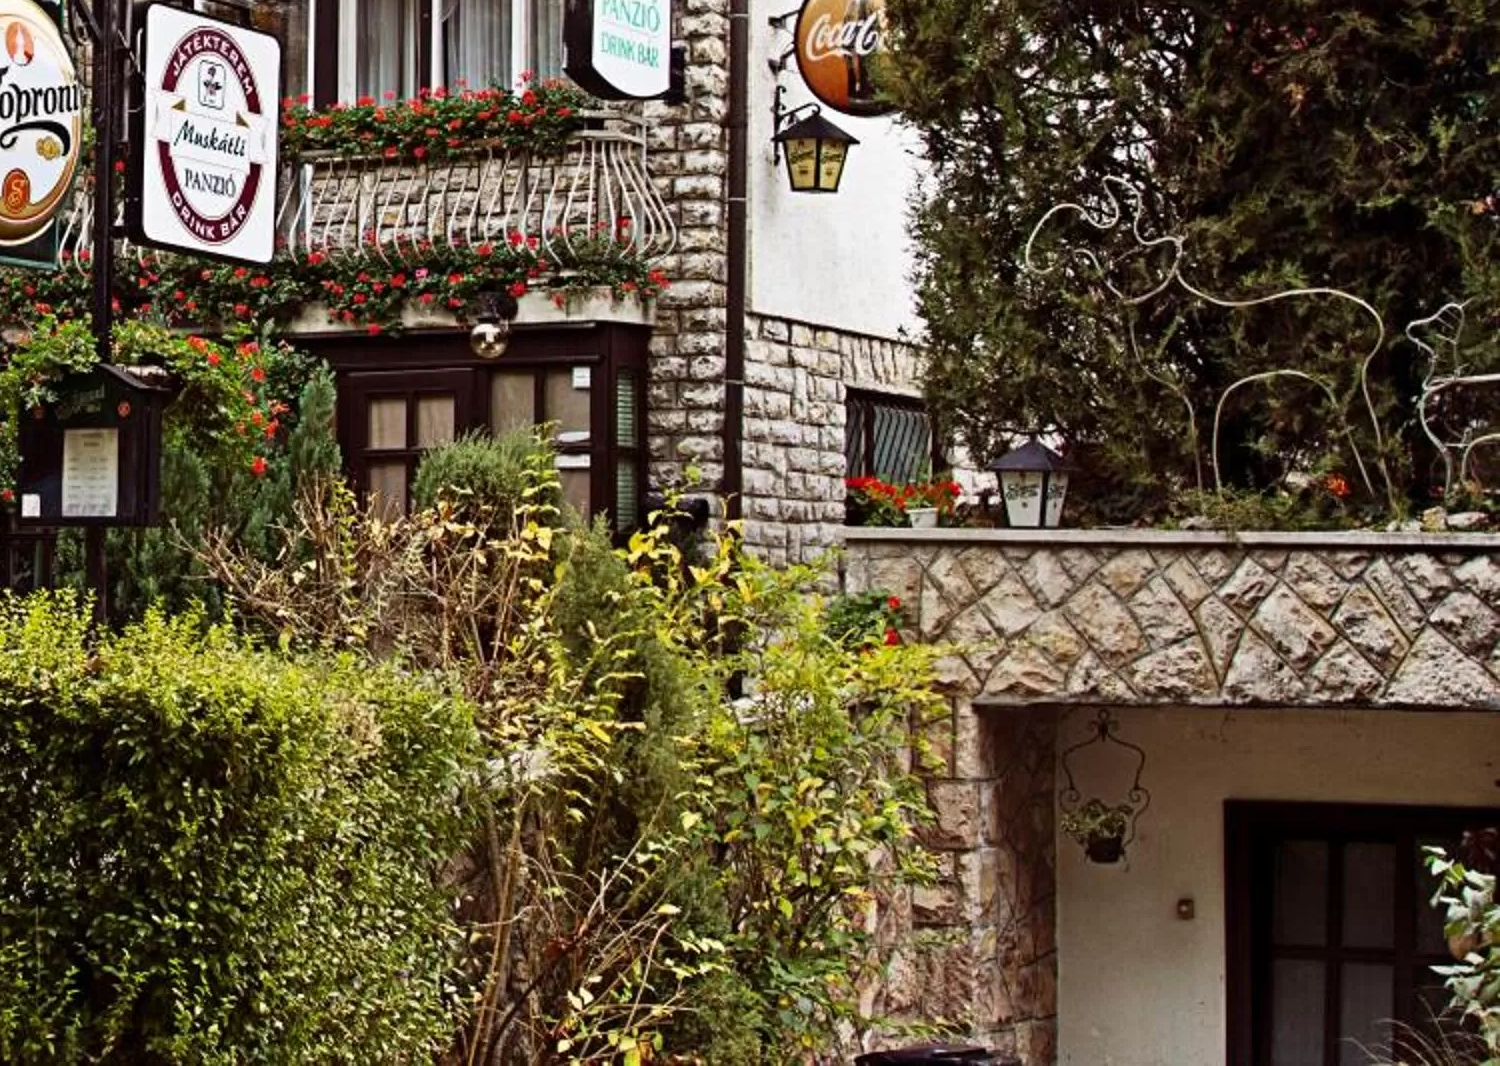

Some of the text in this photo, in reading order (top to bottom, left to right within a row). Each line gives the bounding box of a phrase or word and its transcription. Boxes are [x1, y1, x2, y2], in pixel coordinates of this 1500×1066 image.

[600, 32, 635, 62] DRINK
[173, 119, 246, 157] Muskátli
[185, 168, 236, 198] PANZIÓ
[172, 191, 215, 239] DRINK
